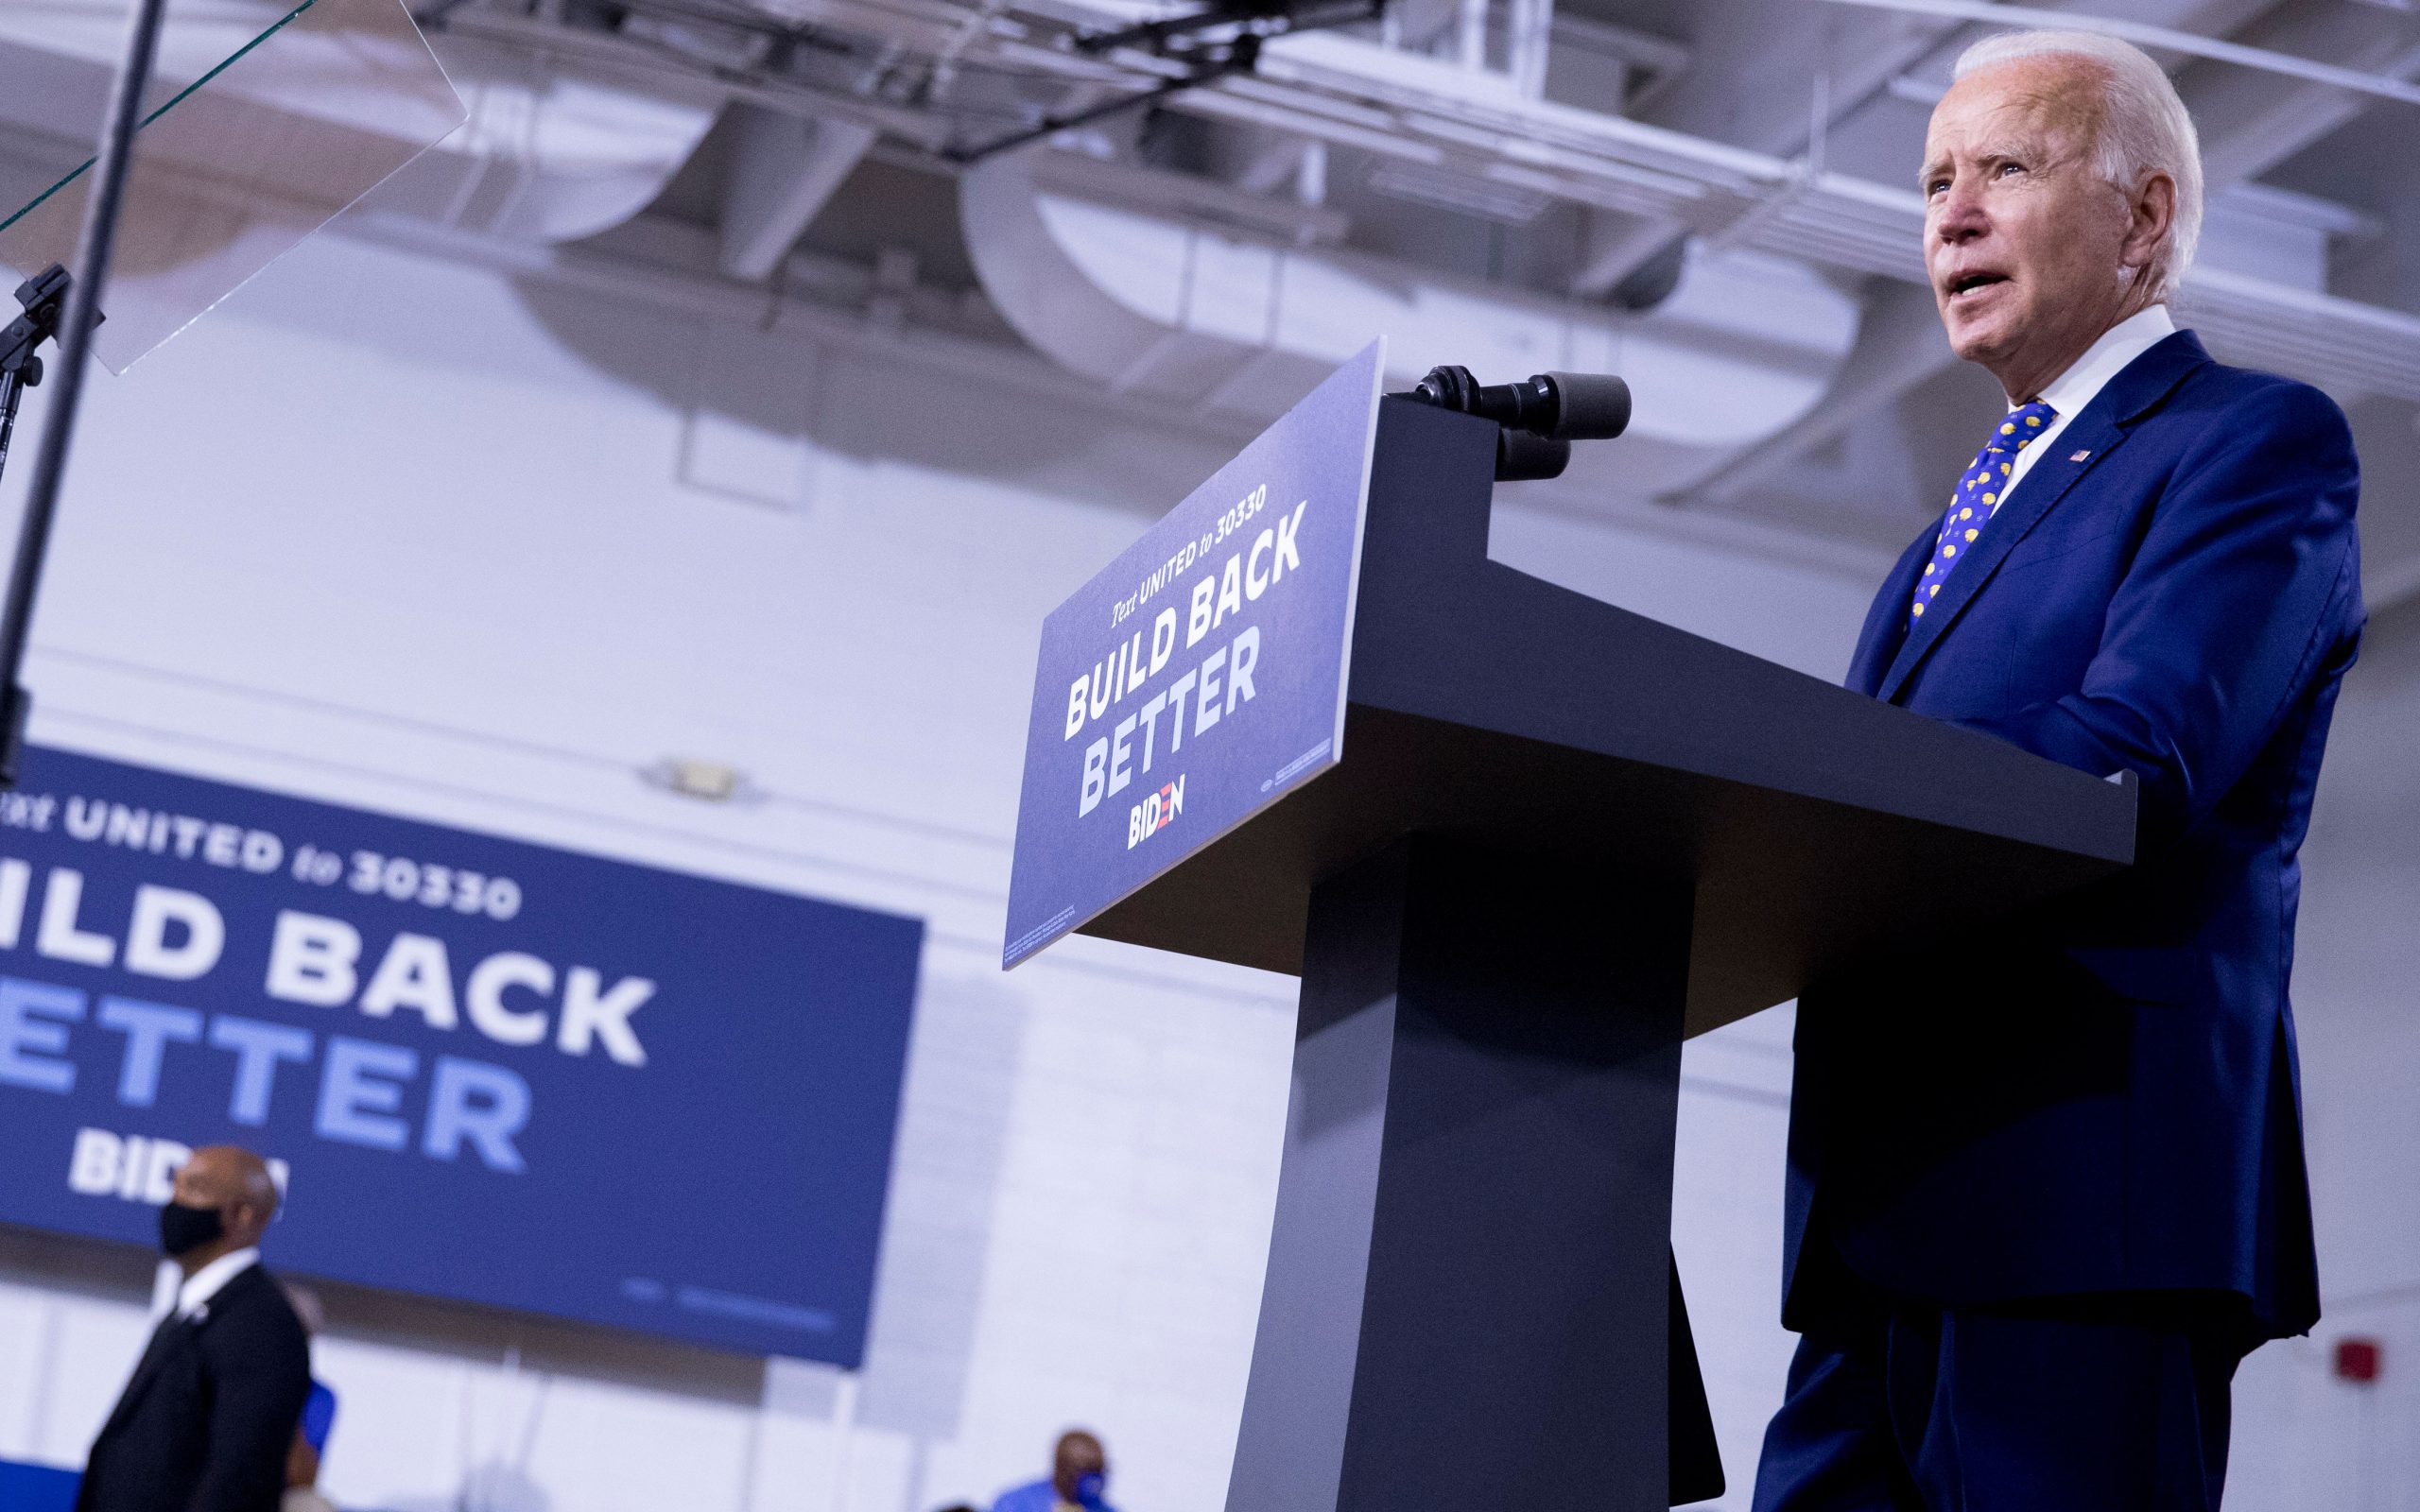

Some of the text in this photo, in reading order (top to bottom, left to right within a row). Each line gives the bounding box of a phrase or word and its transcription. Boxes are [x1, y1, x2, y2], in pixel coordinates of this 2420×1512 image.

[1064, 500, 1307, 742] BUILD BACK
[1112, 484, 1267, 628] Text UNITED to 30330
[1079, 626, 1260, 819] BETTER
[64, 794, 284, 874] UNITED
[291, 845, 342, 885] to
[347, 850, 522, 921] 30330
[1128, 773, 1185, 850] BIDEN
[265, 907, 657, 1068] BACK
